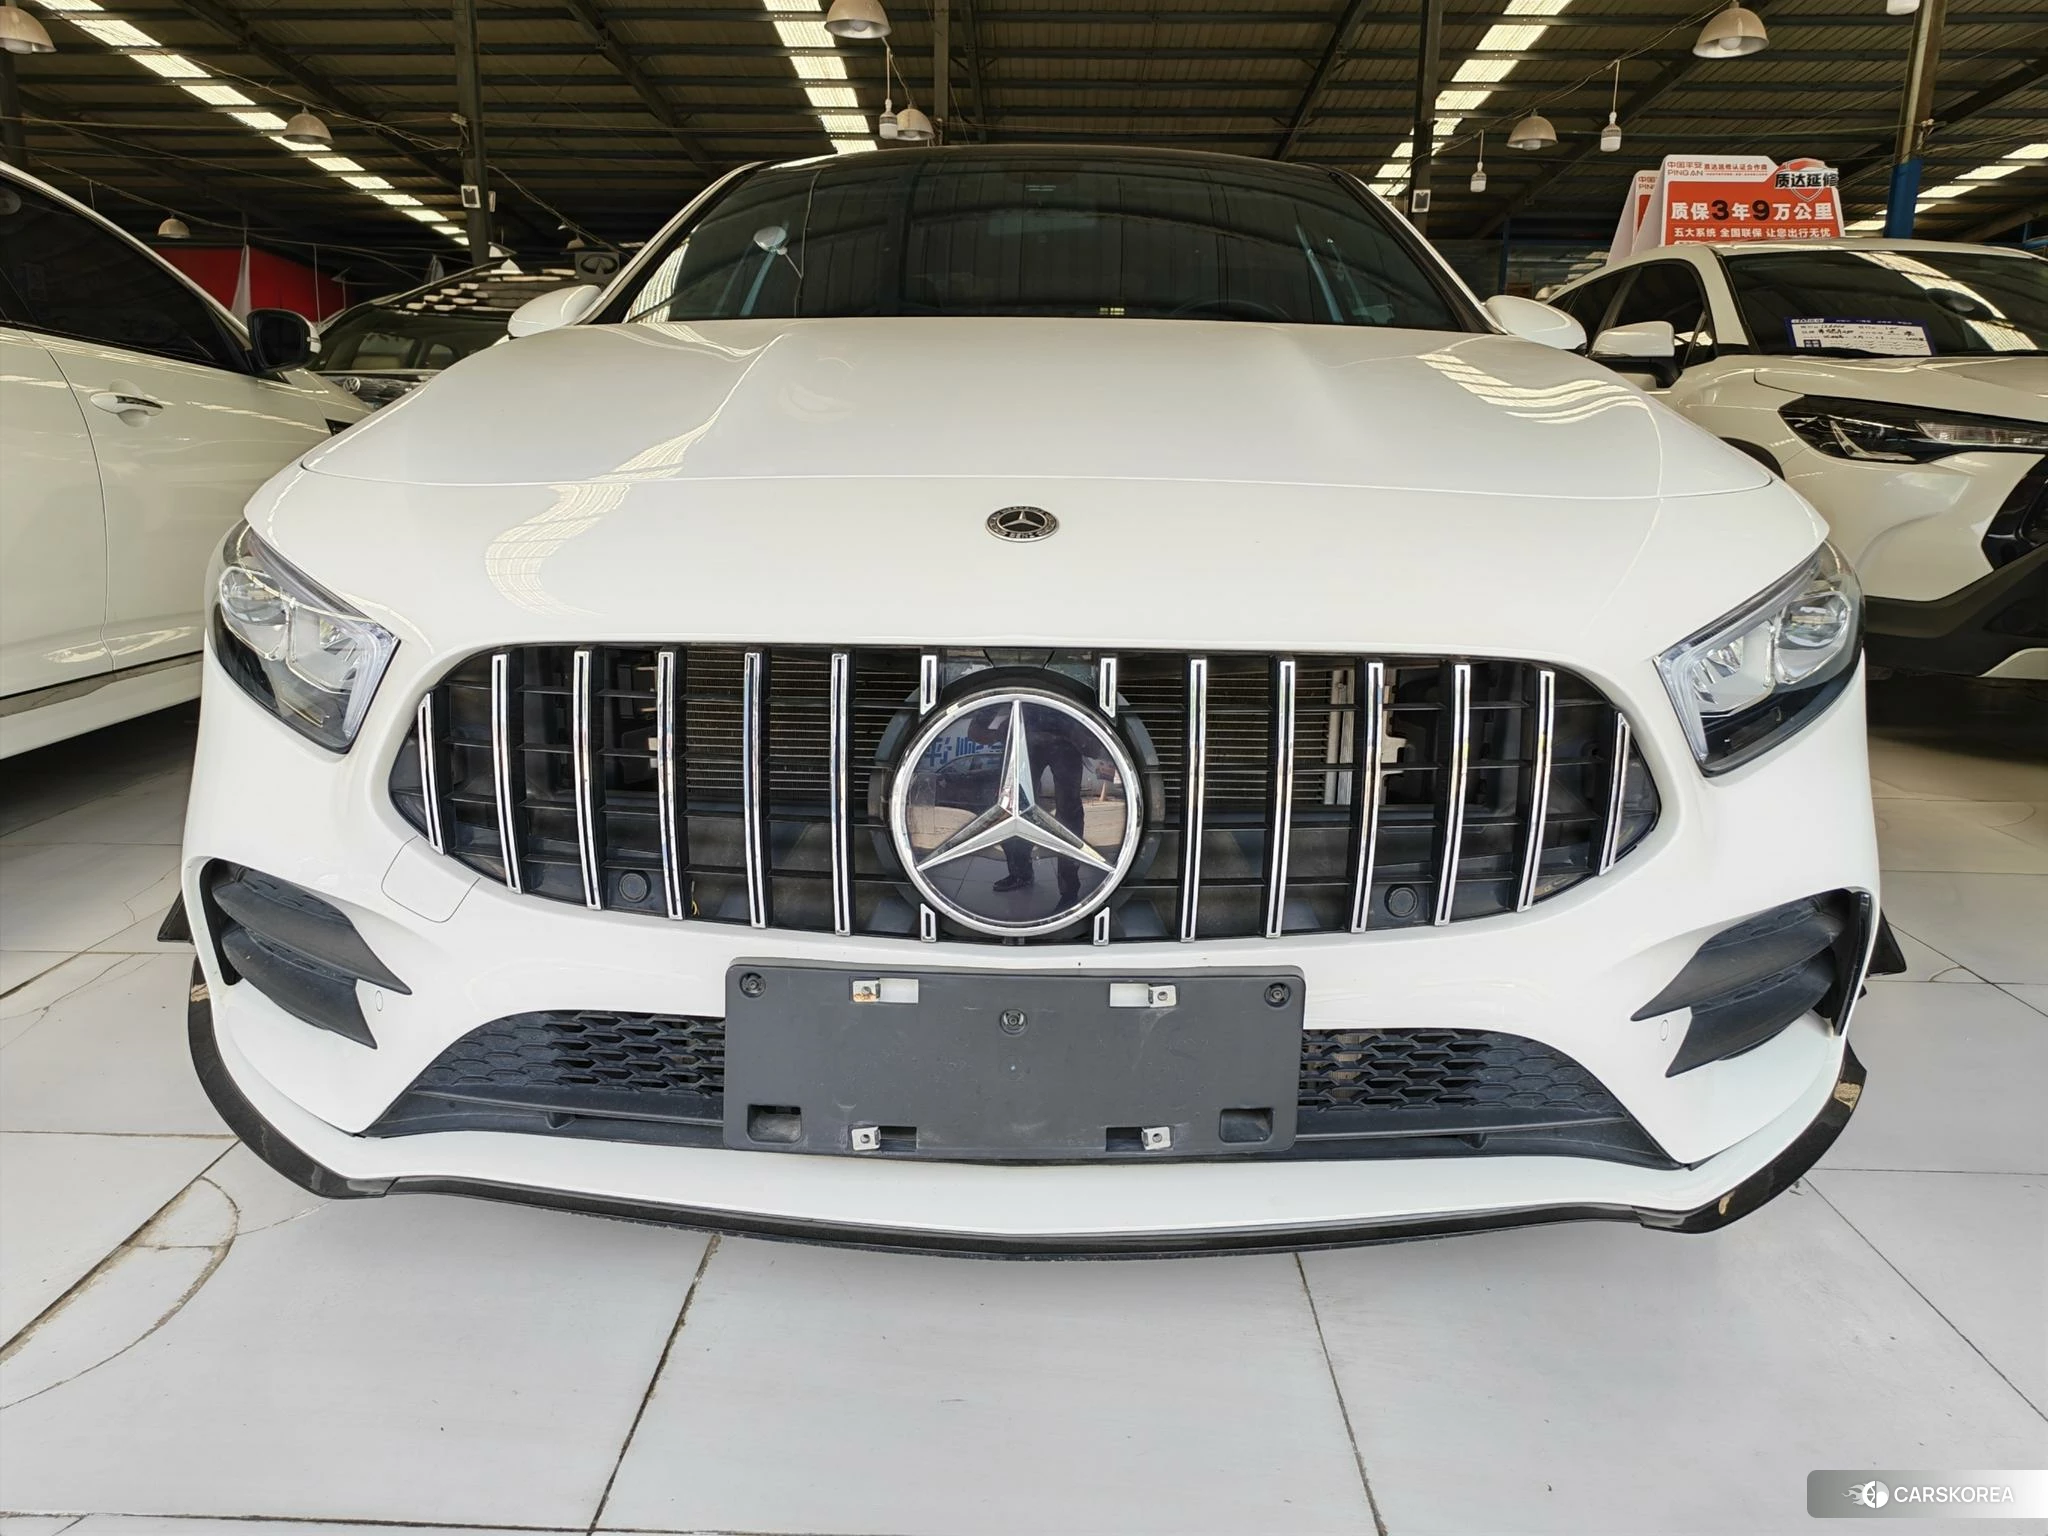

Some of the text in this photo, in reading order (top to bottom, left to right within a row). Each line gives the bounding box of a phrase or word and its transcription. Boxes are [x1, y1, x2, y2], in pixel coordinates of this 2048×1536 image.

[1667, 161, 1703, 169] 中国平安
[1775, 172, 1838, 187] 质达延修
[1671, 199, 1834, 221] 质保3年9万公里
[1674, 228, 1831, 238] 五大系统 全国联保 让您出行无忧
